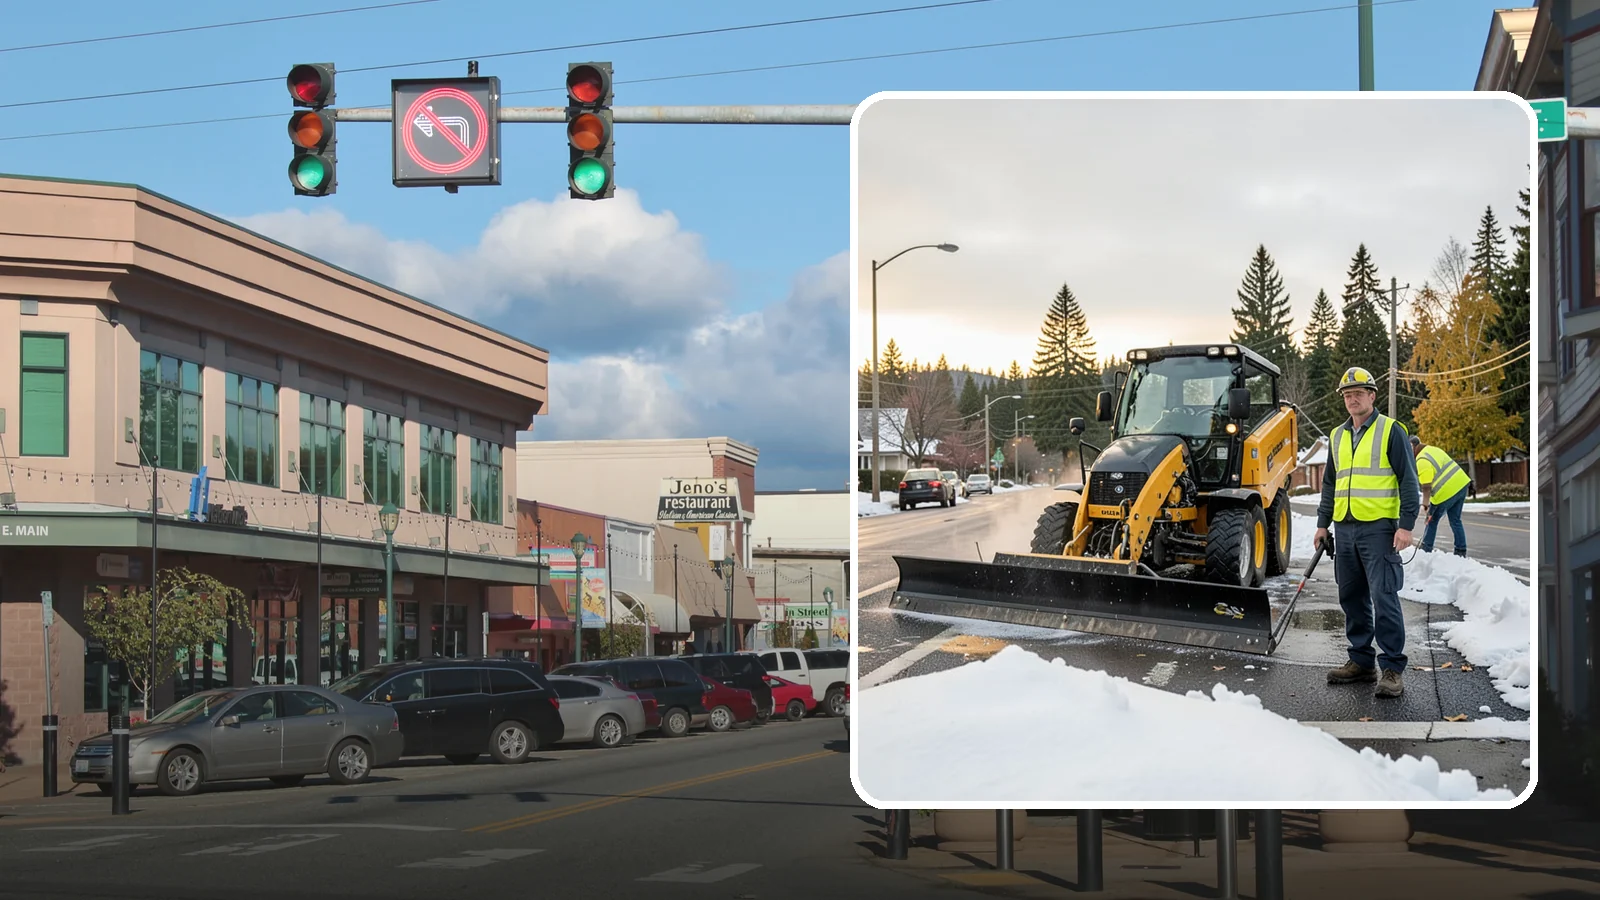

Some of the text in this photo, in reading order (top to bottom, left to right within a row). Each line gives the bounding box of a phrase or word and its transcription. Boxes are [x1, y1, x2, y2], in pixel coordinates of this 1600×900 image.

[670, 480, 727, 494] Jeno's
[665, 496, 731, 509] restaurant
[686, 509, 714, 519] American
[715, 509, 738, 519] Cuisine
[2, 525, 49, 536] E. MAIN
[797, 608, 828, 617] Street
